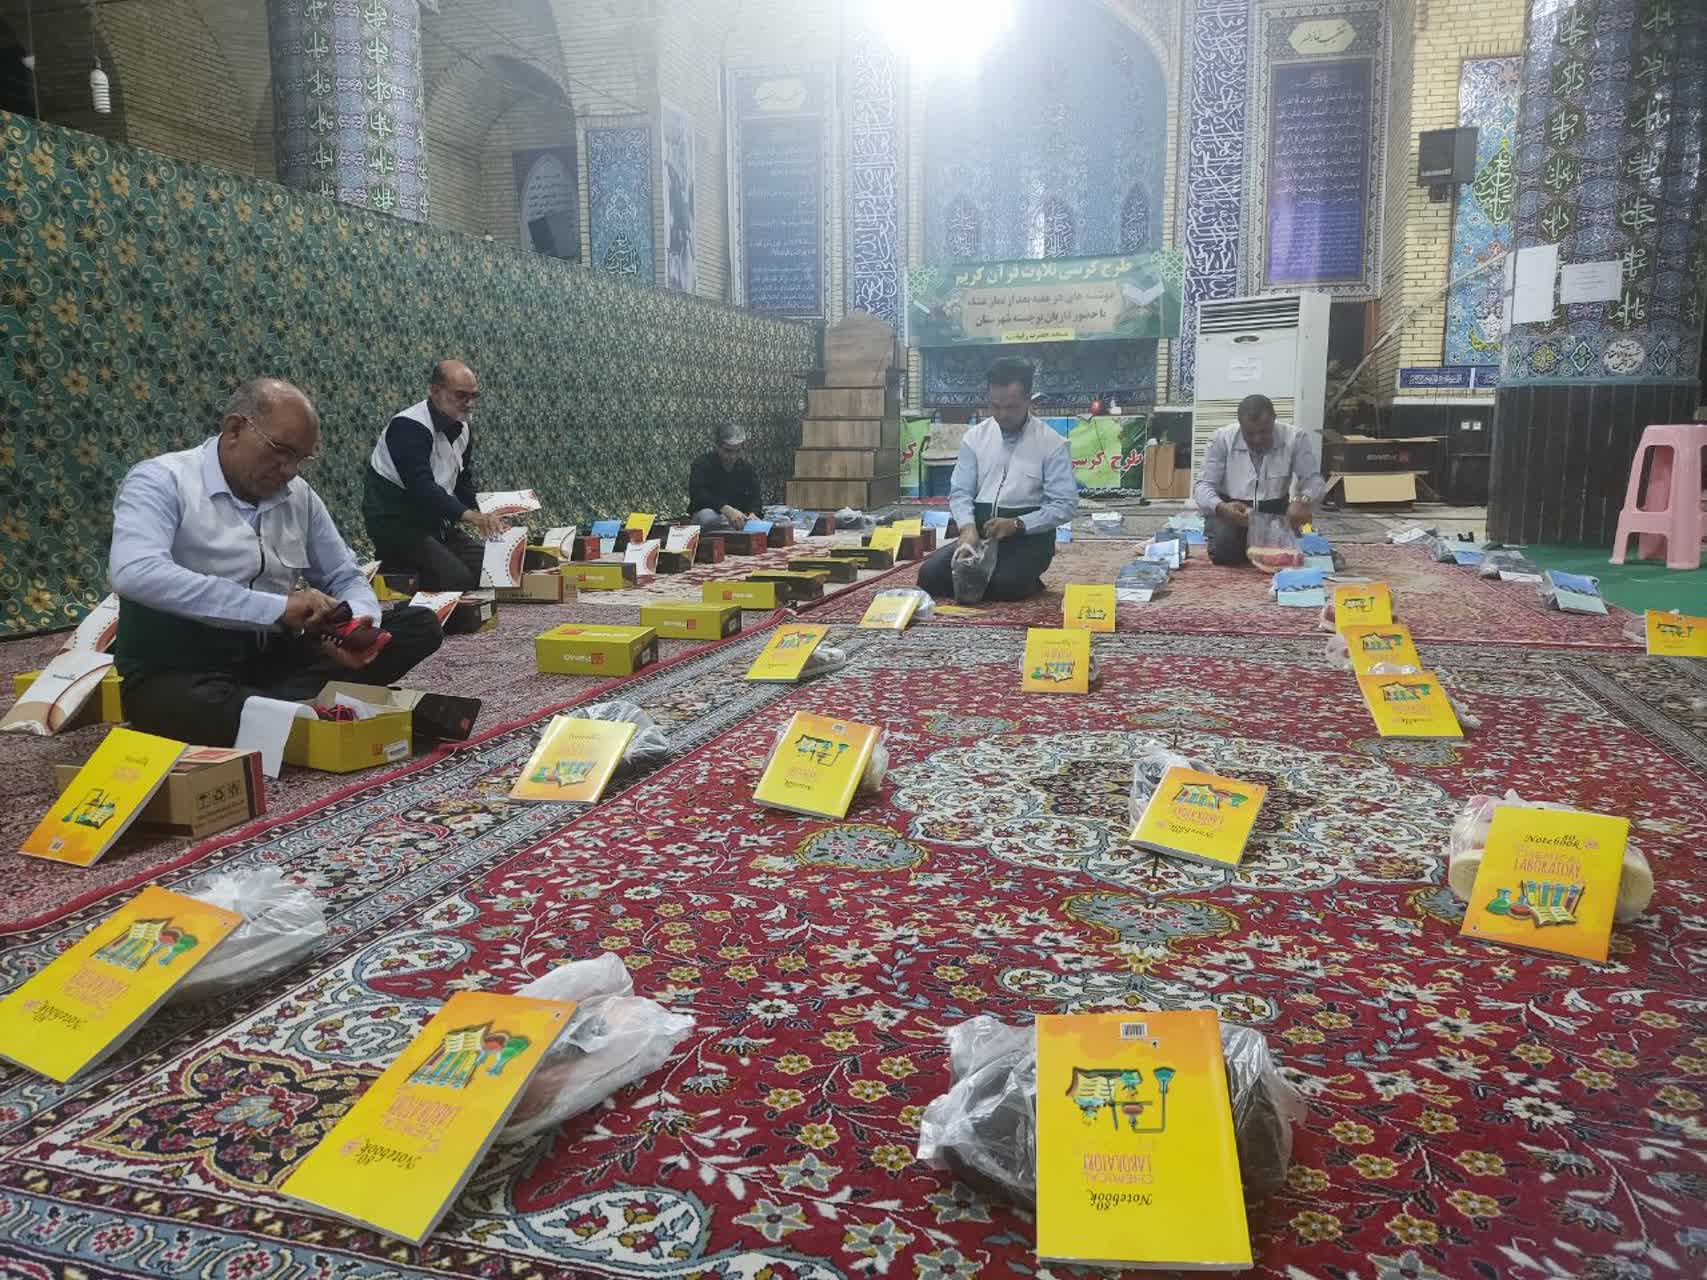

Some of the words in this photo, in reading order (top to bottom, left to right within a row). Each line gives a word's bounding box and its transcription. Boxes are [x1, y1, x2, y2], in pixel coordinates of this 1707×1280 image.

[954, 266, 985, 287] کریم
[986, 263, 1019, 285] قرآن
[1022, 262, 1057, 282] تلاوت
[1058, 260, 1099, 281] کرسی
[1100, 258, 1134, 278] طرح
[1110, 448, 1144, 472] طرح
[1523, 833, 1584, 850] Notebook
[353, 1137, 424, 1170] Notebook
[1087, 1188, 1152, 1206] Notebook
